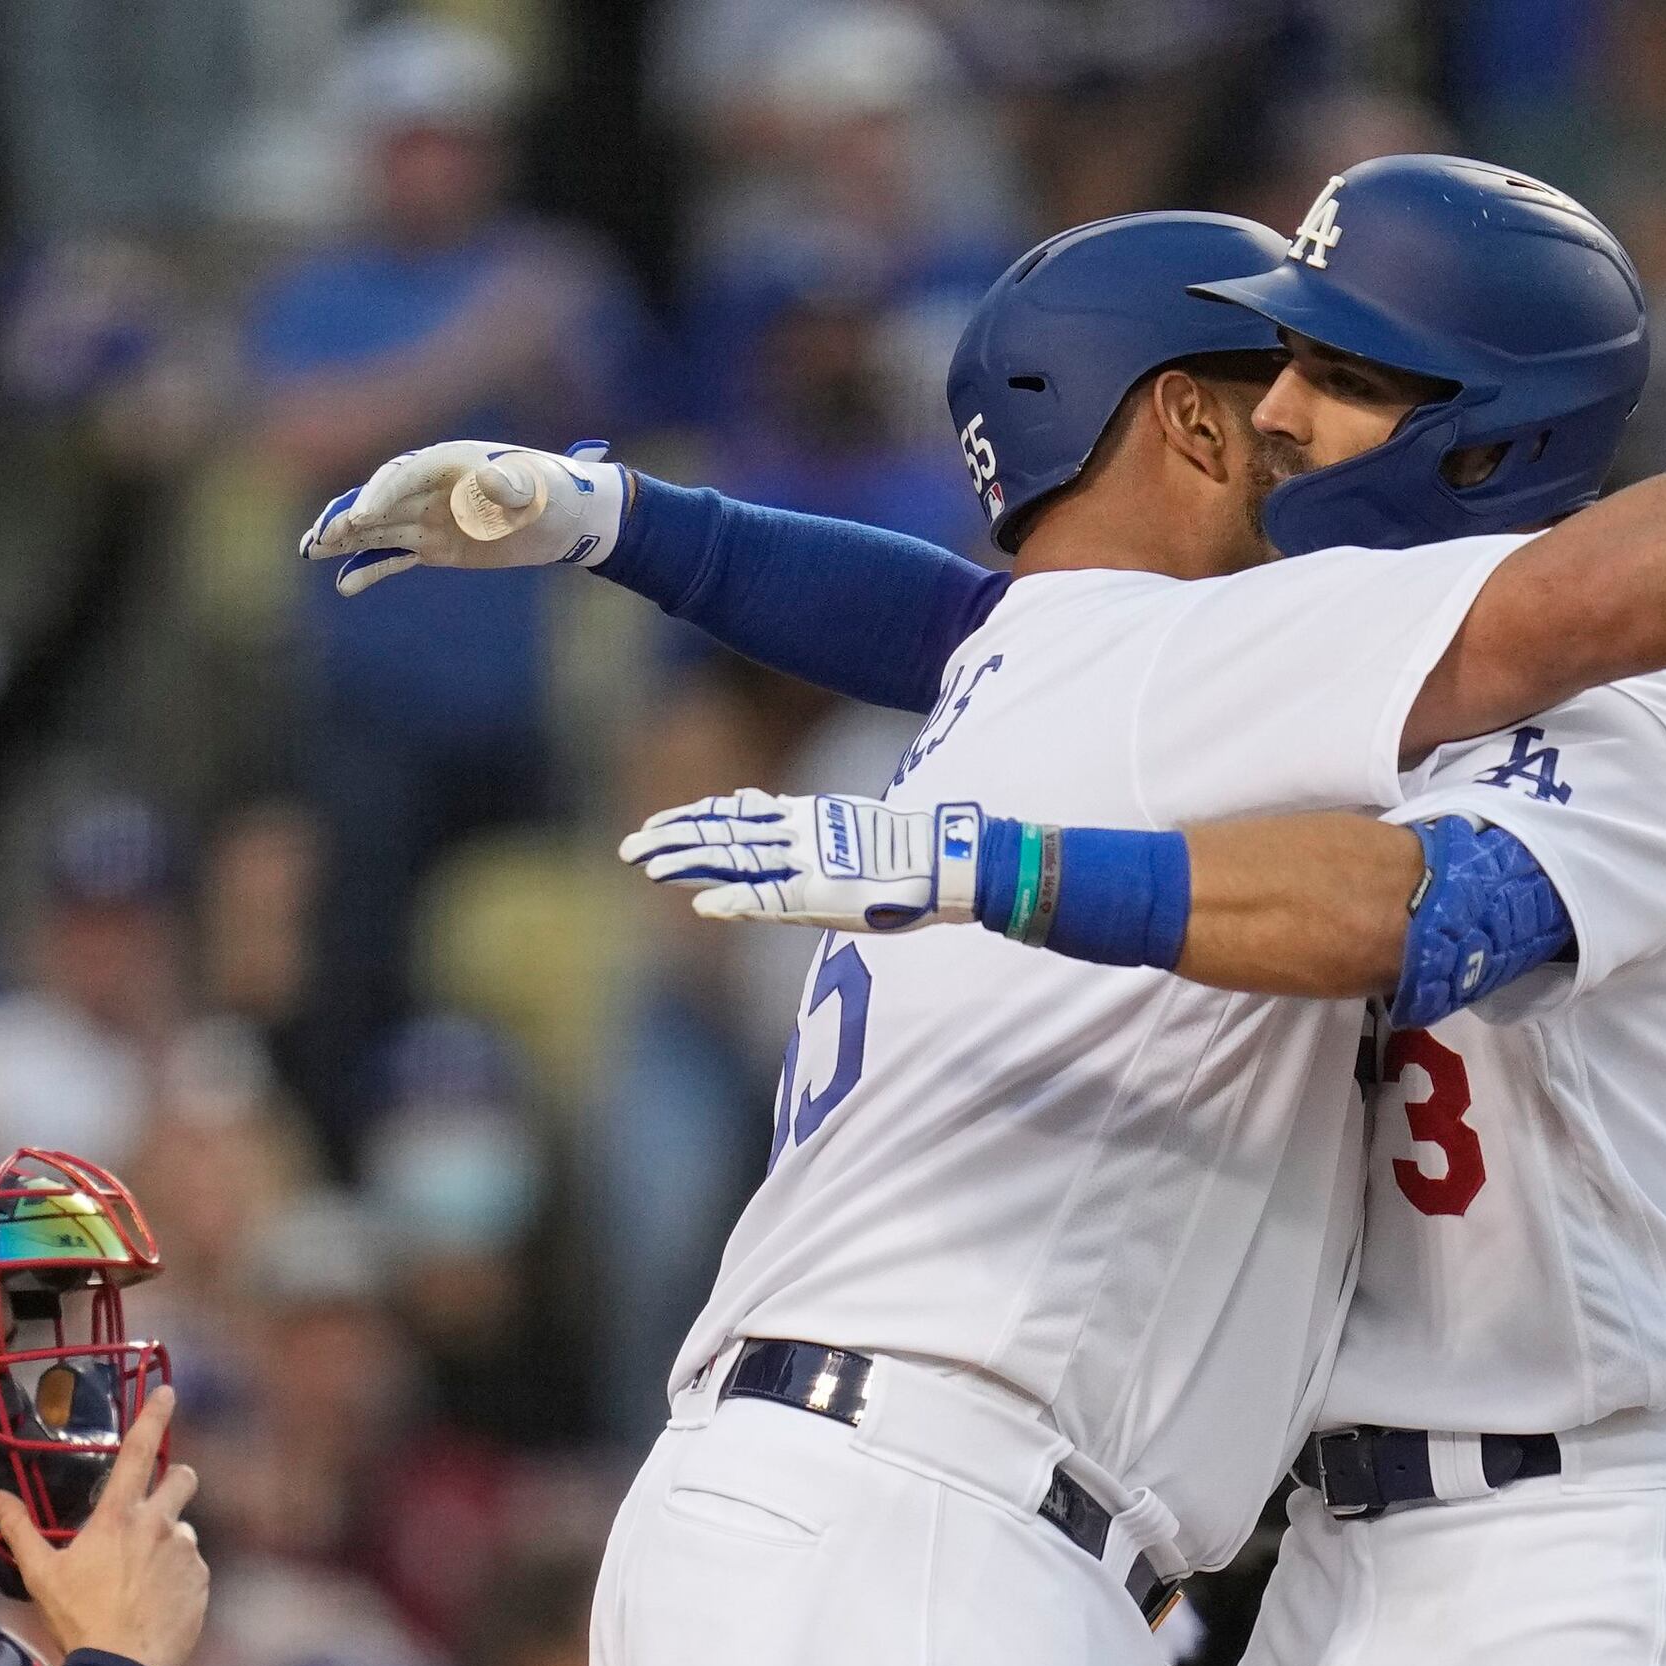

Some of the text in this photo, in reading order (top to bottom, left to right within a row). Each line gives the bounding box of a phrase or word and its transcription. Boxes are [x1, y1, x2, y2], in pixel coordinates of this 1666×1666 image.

[1287, 175, 1346, 270] LA
[960, 412, 996, 494] 55
[1472, 725, 1573, 805] LA
[826, 802, 855, 871] Franklin
[1383, 1024, 1487, 1217] 3
